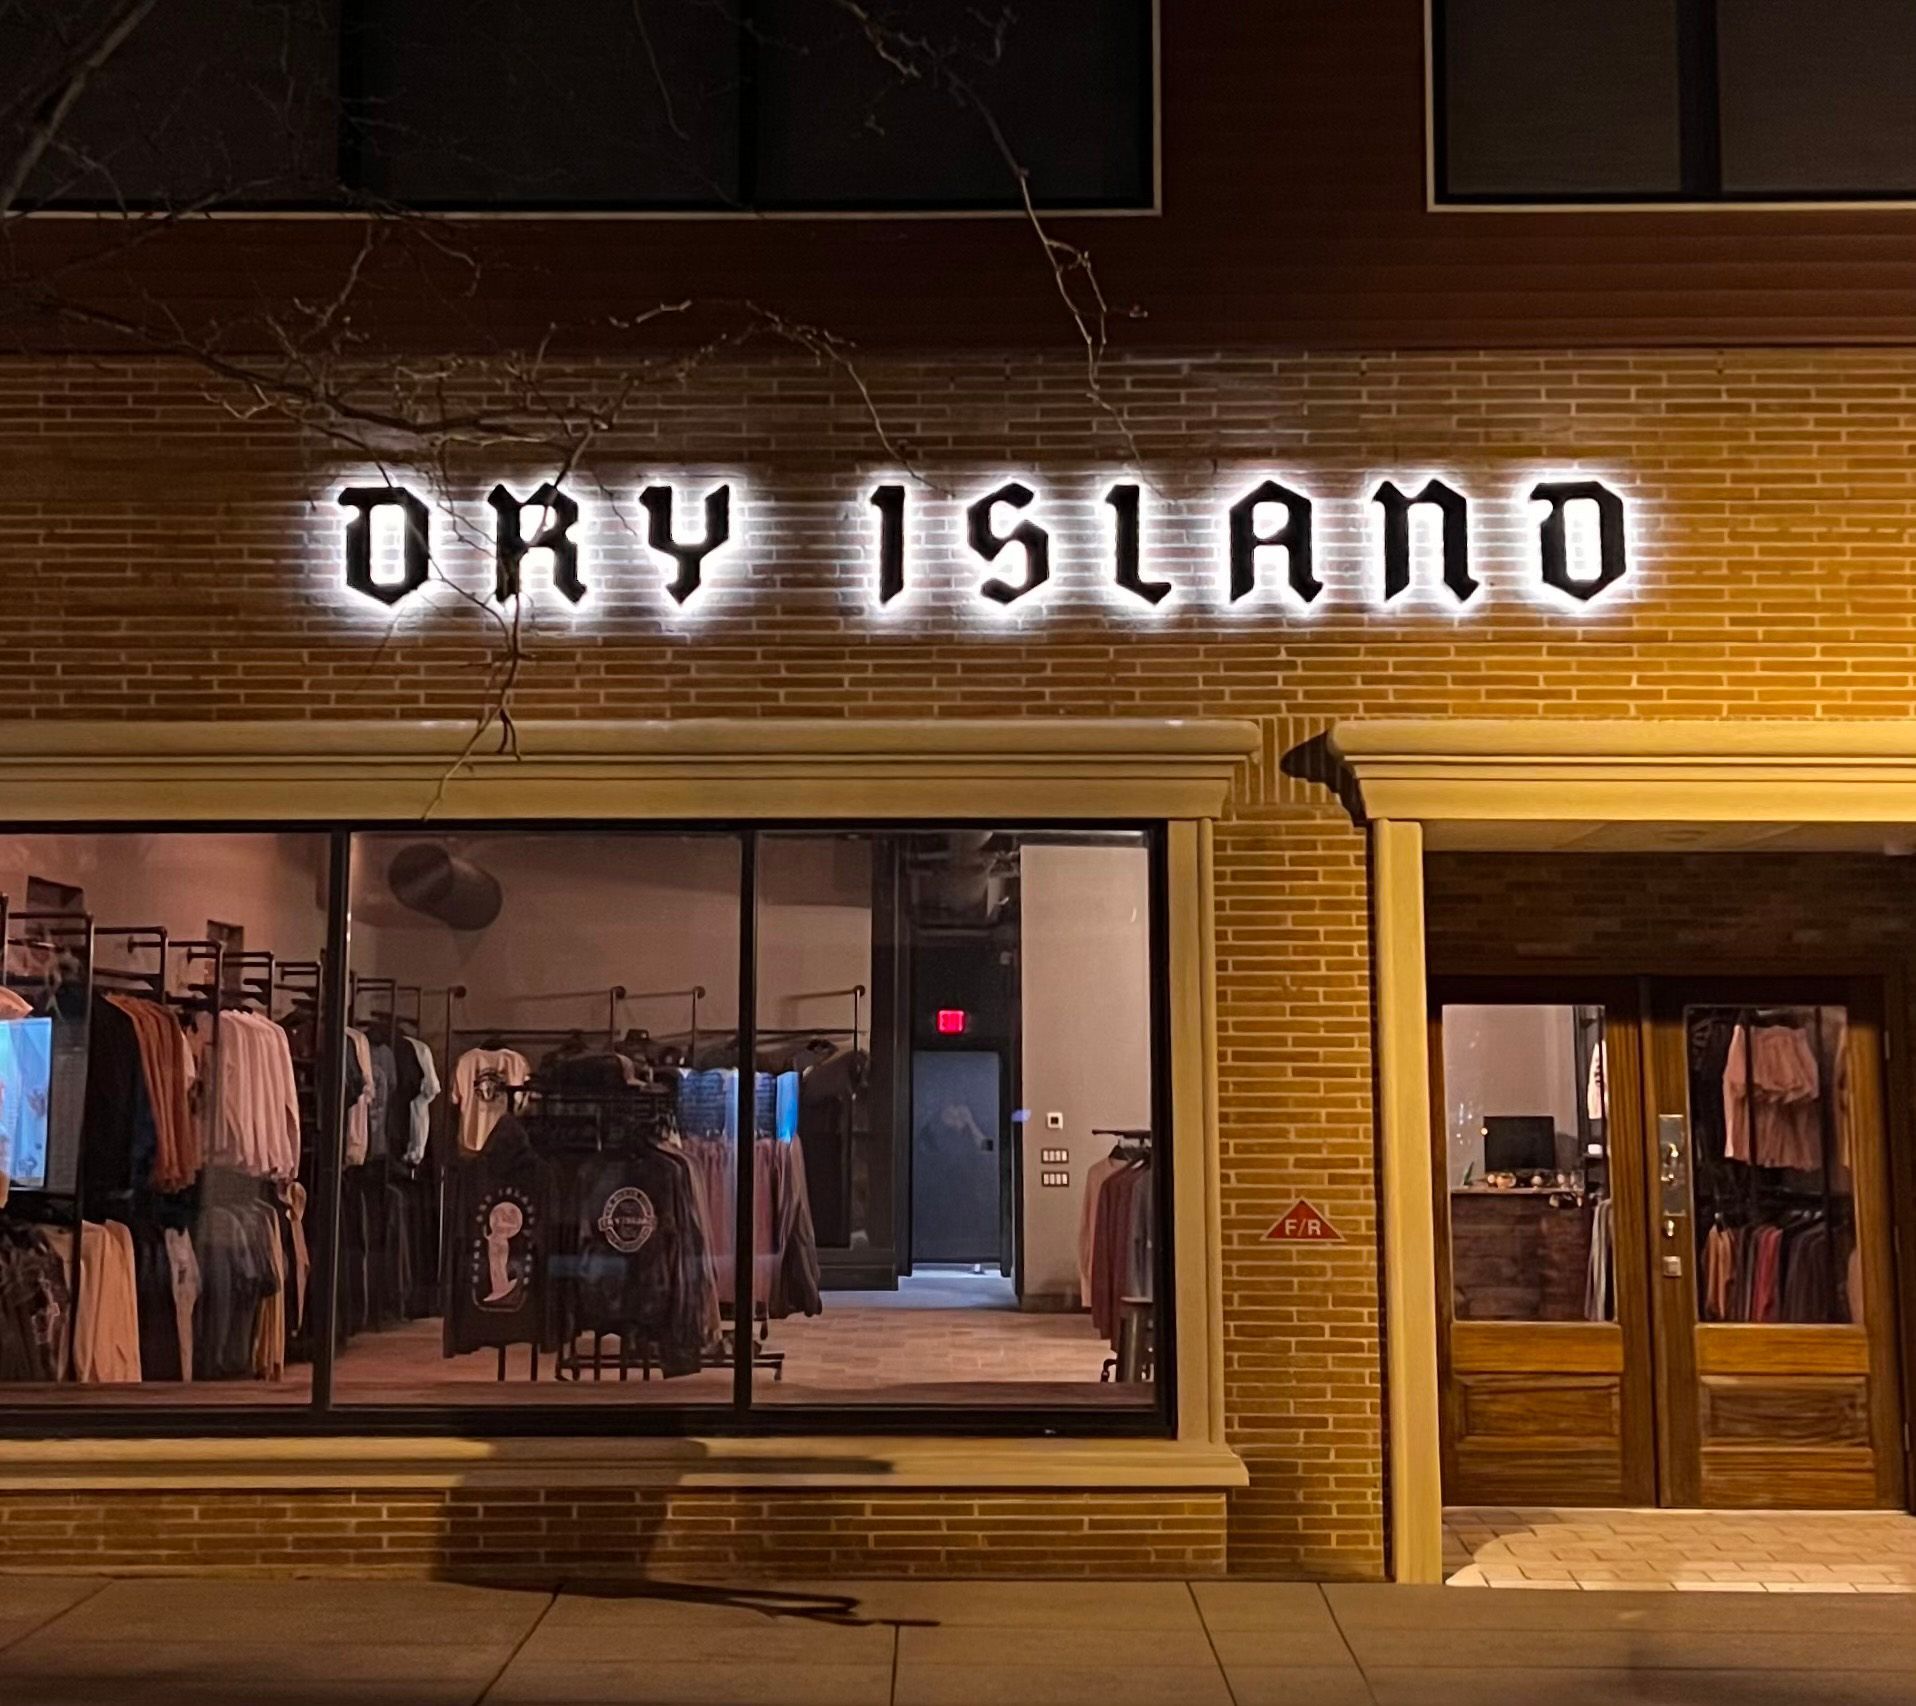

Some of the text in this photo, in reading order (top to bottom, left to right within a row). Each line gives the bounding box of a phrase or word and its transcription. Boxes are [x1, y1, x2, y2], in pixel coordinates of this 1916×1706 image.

[338, 479, 1626, 605] DRY ISLAND
[1284, 1218, 1321, 1236] F/R
